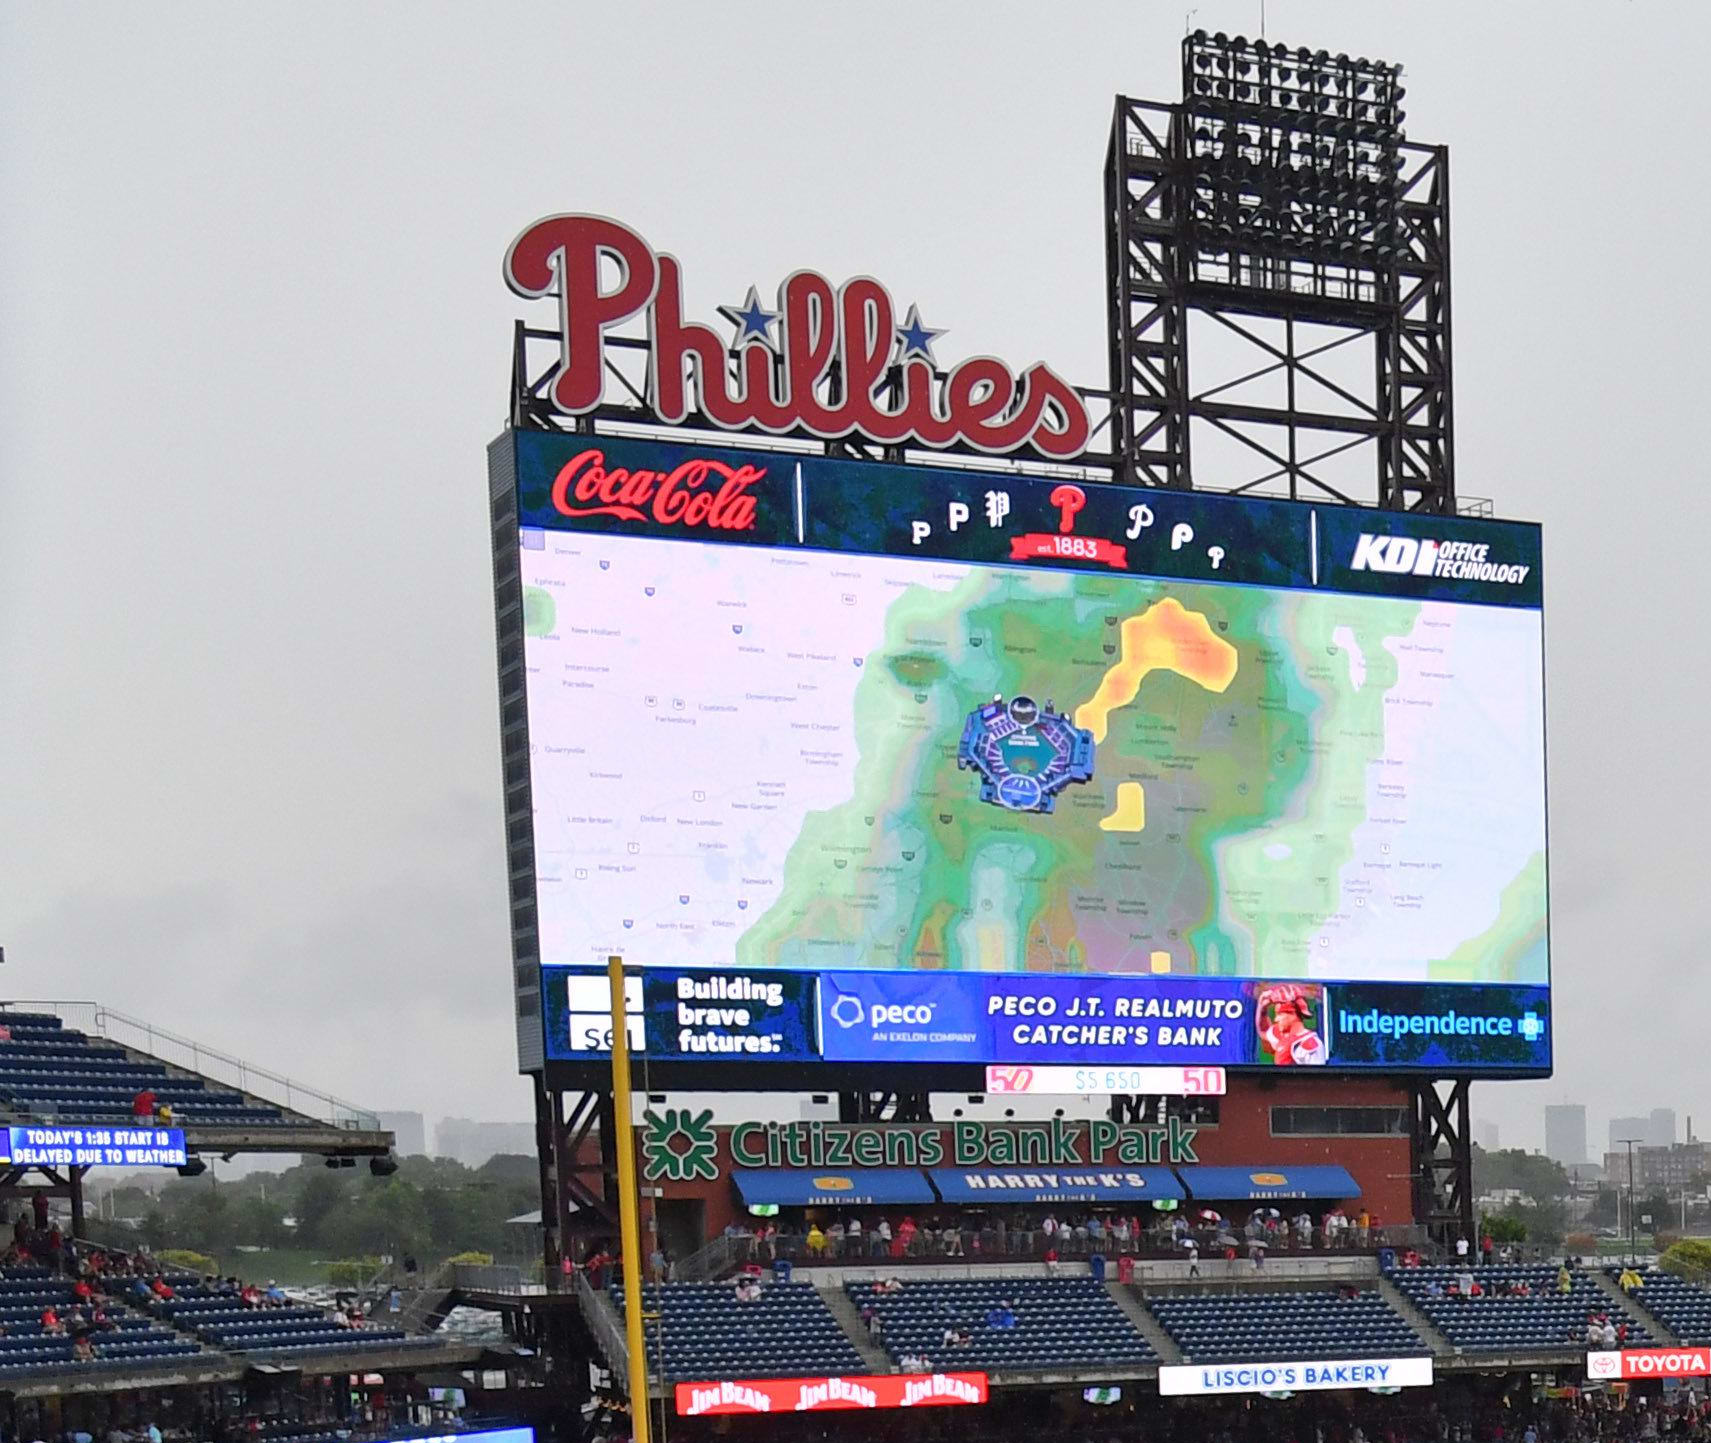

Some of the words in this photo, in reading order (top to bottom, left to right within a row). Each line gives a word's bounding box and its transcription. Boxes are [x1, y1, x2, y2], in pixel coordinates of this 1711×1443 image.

[503, 213, 1092, 460] Phillies
[551, 449, 768, 530] Coca-Cola
[950, 502, 969, 531] P
[1053, 535, 1097, 558] 1883
[1352, 534, 1438, 576] KDI
[1438, 541, 1488, 563] OFFICE
[1434, 559, 1530, 585] TECHNOLOGY
[678, 977, 783, 1006] Building
[678, 1002, 750, 1026] brave
[871, 1004, 932, 1029] peco
[988, 996, 1055, 1017] PECO
[1066, 997, 1104, 1017] J.T.
[1115, 998, 1243, 1019] REALMUTO
[1013, 1025, 1149, 1046] CATCHER'S
[1158, 1027, 1222, 1047] BANK
[1339, 1008, 1513, 1040] Independence
[928, 1033, 976, 1043] COMPANY
[1183, 1069, 1222, 1093] 50
[26, 1131, 83, 1146] TODAY'S
[114, 1131, 153, 1147] START
[156, 1131, 169, 1147] IS
[730, 1120, 943, 1167] Citizens
[953, 1117, 1084, 1166] Bank
[1088, 1115, 1201, 1165] Park
[14, 1148, 73, 1165] DELAYED
[75, 1149, 102, 1164] DUE
[105, 1149, 123, 1164] TO
[125, 1149, 186, 1165] WEATHER
[964, 1174, 1062, 1191] HARRY
[1063, 1175, 1097, 1189] THE
[1099, 1172, 1147, 1191] K'S
[1626, 1353, 1706, 1372] TOYOTA
[932, 1373, 980, 1403] BEAM
[1203, 1368, 1297, 1388] LISCIO'S
[1305, 1365, 1391, 1384] BAKERY
[721, 1381, 770, 1412] BEAM
[827, 1377, 876, 1408] BEAM
